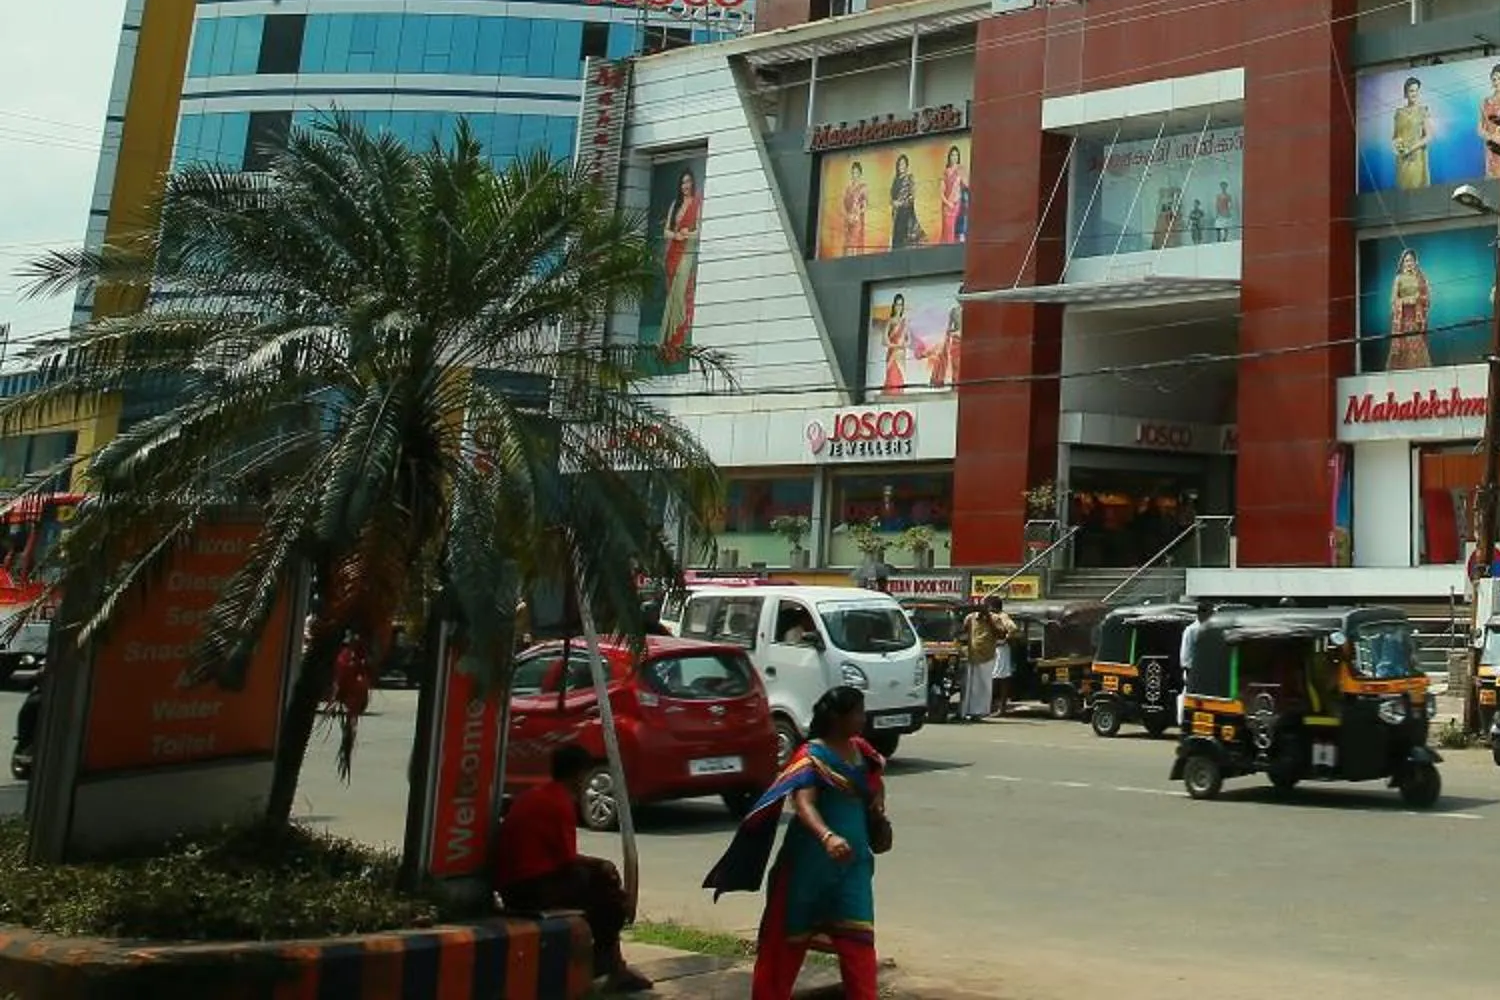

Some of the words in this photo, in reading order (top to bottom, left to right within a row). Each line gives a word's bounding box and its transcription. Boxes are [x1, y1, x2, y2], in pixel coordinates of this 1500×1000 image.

[1344, 387, 1492, 425] Mahalekshm
[828, 410, 914, 442] JOSCO
[828, 440, 913, 458] JEWELLERS
[913, 578, 937, 596] BOOK
[152, 700, 224, 722] Water
[151, 733, 217, 756] Toilet
[444, 698, 487, 864] Welcome
